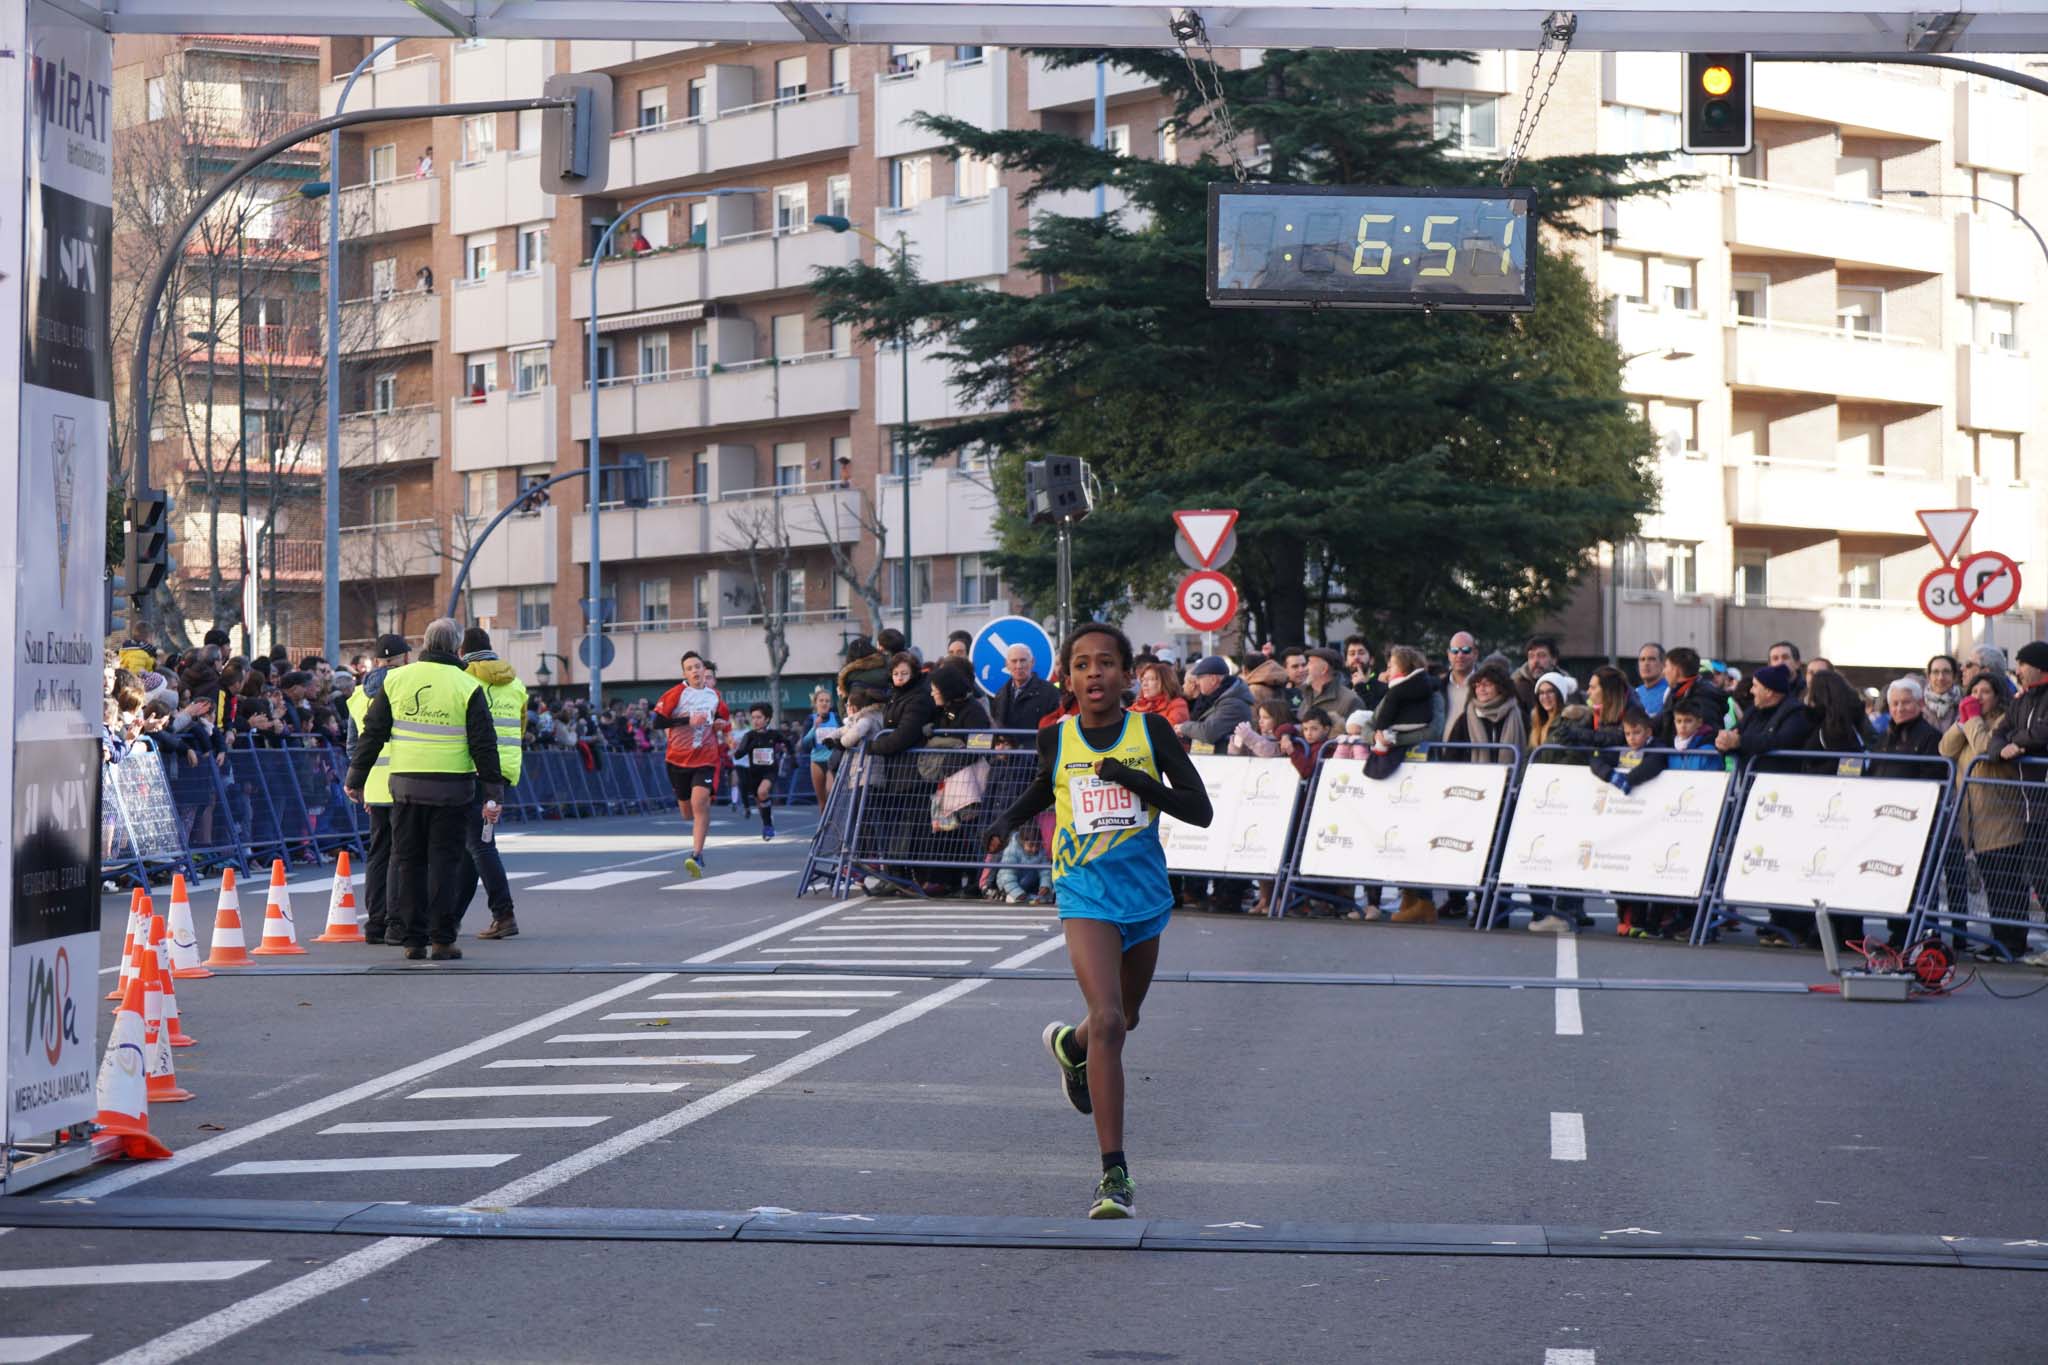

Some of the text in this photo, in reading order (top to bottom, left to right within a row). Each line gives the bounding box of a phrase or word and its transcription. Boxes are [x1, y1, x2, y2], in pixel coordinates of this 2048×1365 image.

[1190, 592, 1222, 610] 30
[25, 630, 44, 665] San
[34, 680, 47, 712] de
[1082, 787, 1132, 813] 6709
[15, 1071, 91, 1113] MERCASALAMANCA
